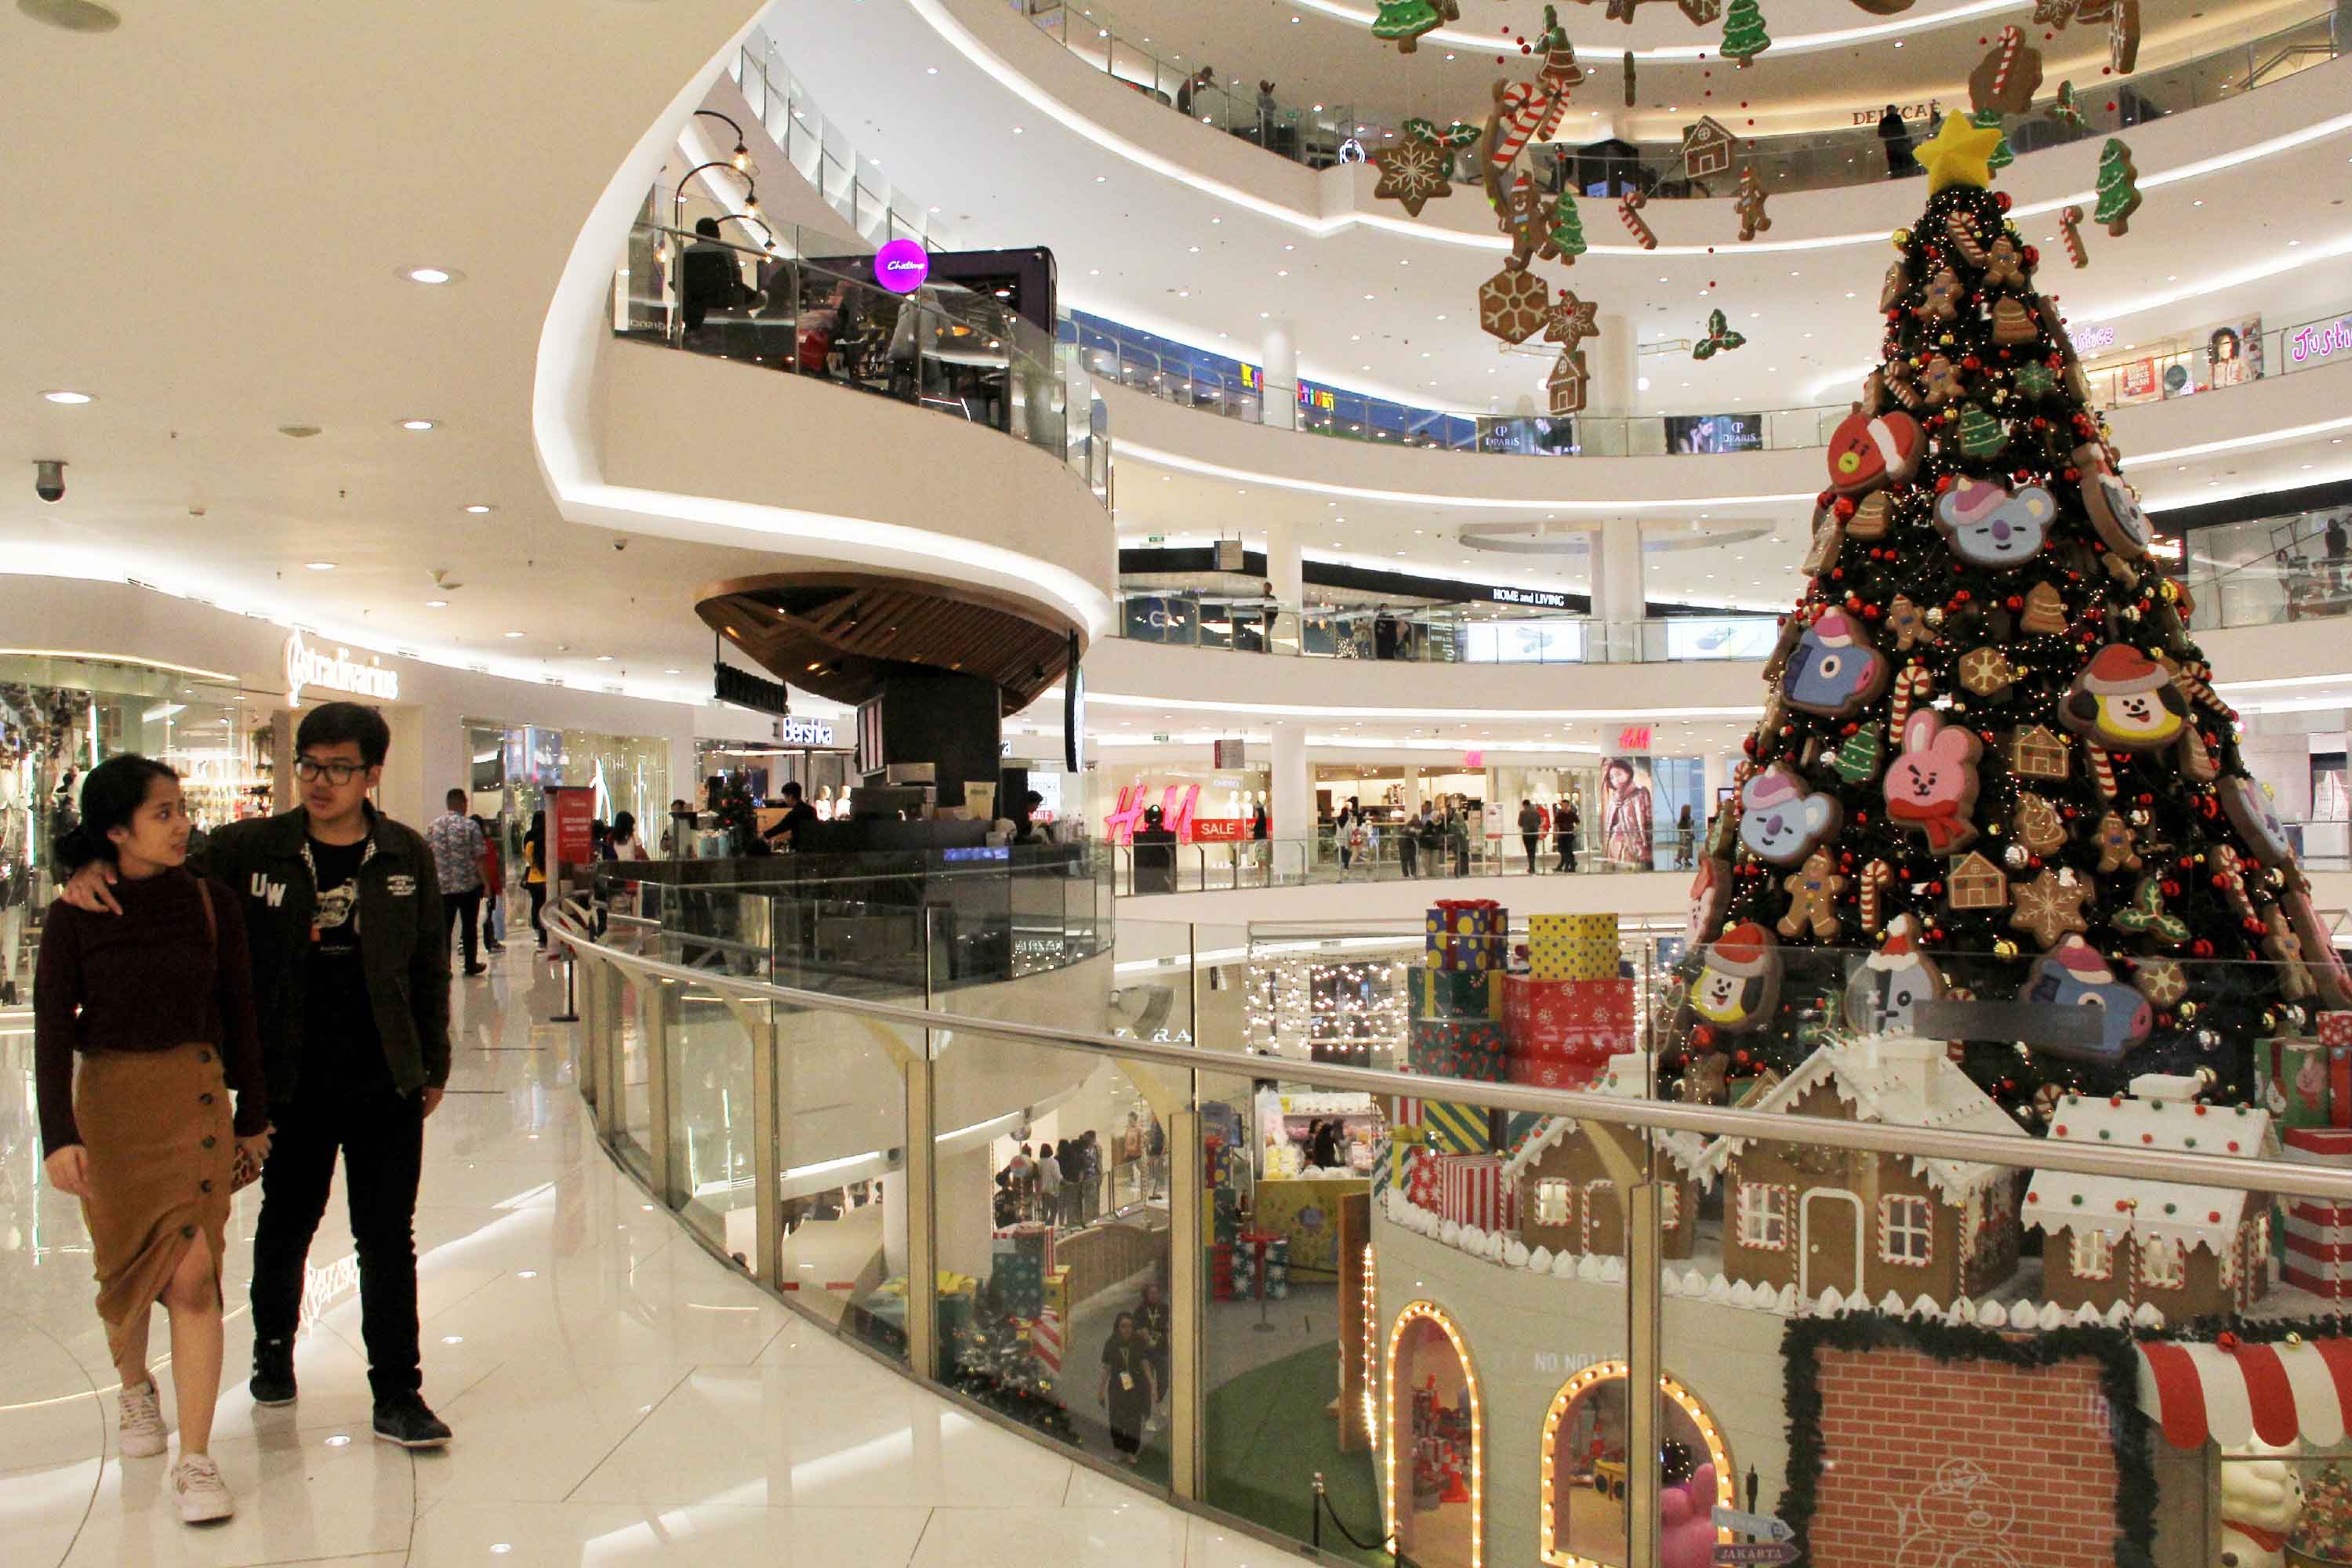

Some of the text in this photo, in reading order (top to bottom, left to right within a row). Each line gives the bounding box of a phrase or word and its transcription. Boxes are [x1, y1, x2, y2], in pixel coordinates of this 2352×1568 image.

[1493, 589, 1564, 607] HOME and LIVING
[782, 717, 833, 745] Bershka
[1105, 784, 1200, 845] HM
[1200, 822, 1236, 835] SALE
[1116, 1028, 1192, 1043] ZRA
[1719, 1548, 1782, 1560] JAKARTA
